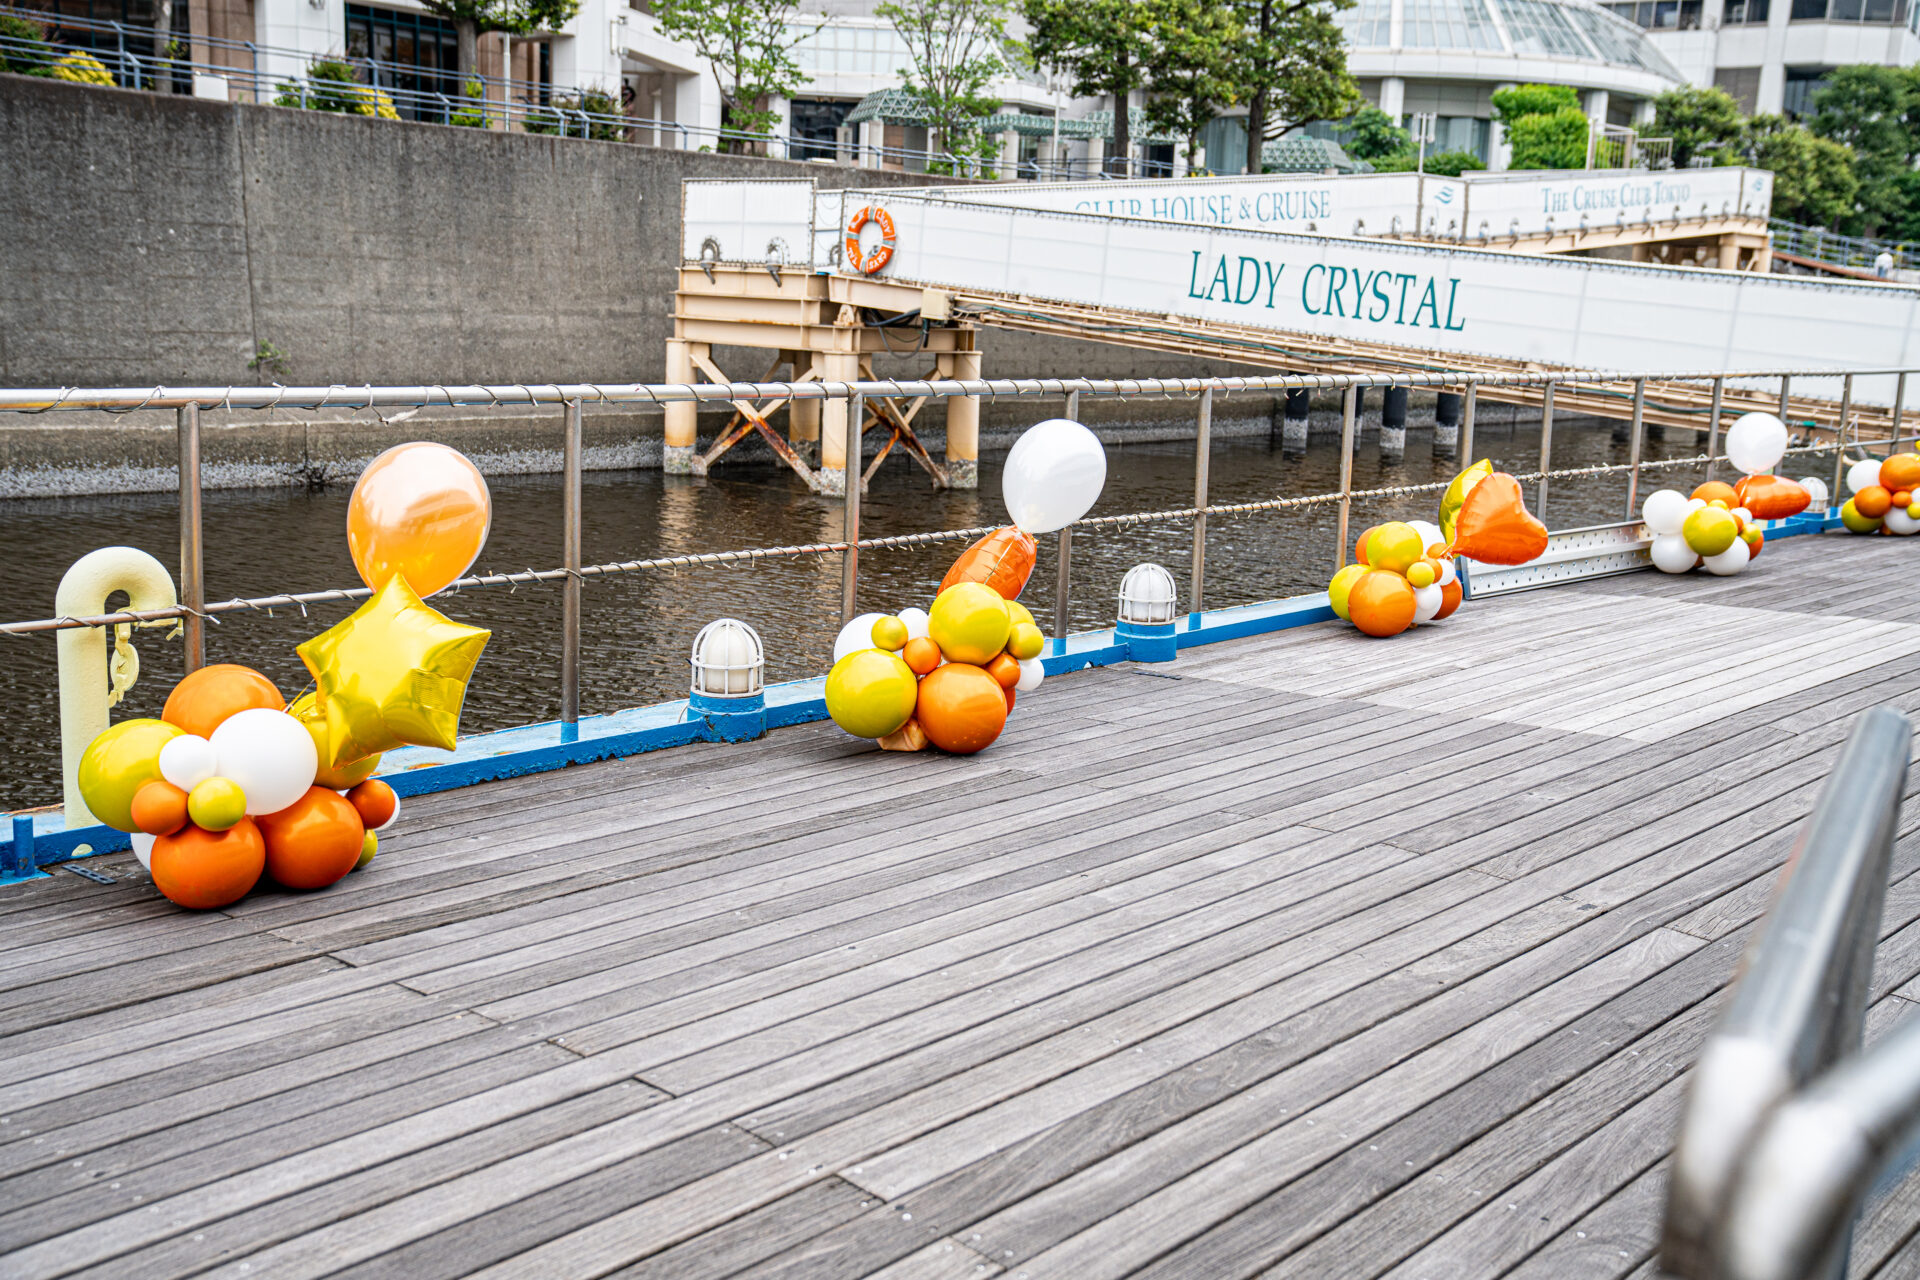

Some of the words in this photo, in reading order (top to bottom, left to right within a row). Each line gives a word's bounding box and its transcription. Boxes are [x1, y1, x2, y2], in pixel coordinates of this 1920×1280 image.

[1152, 194, 1233, 224] HOUSE
[1239, 199, 1251, 219] &
[1255, 189, 1331, 223] CRUISE
[1541, 187, 1570, 213] THE
[1573, 185, 1618, 210] CRUISE
[1620, 183, 1651, 208] CLUB
[1187, 250, 1285, 309] LADY
[1302, 263, 1466, 331] CRYSTAL
